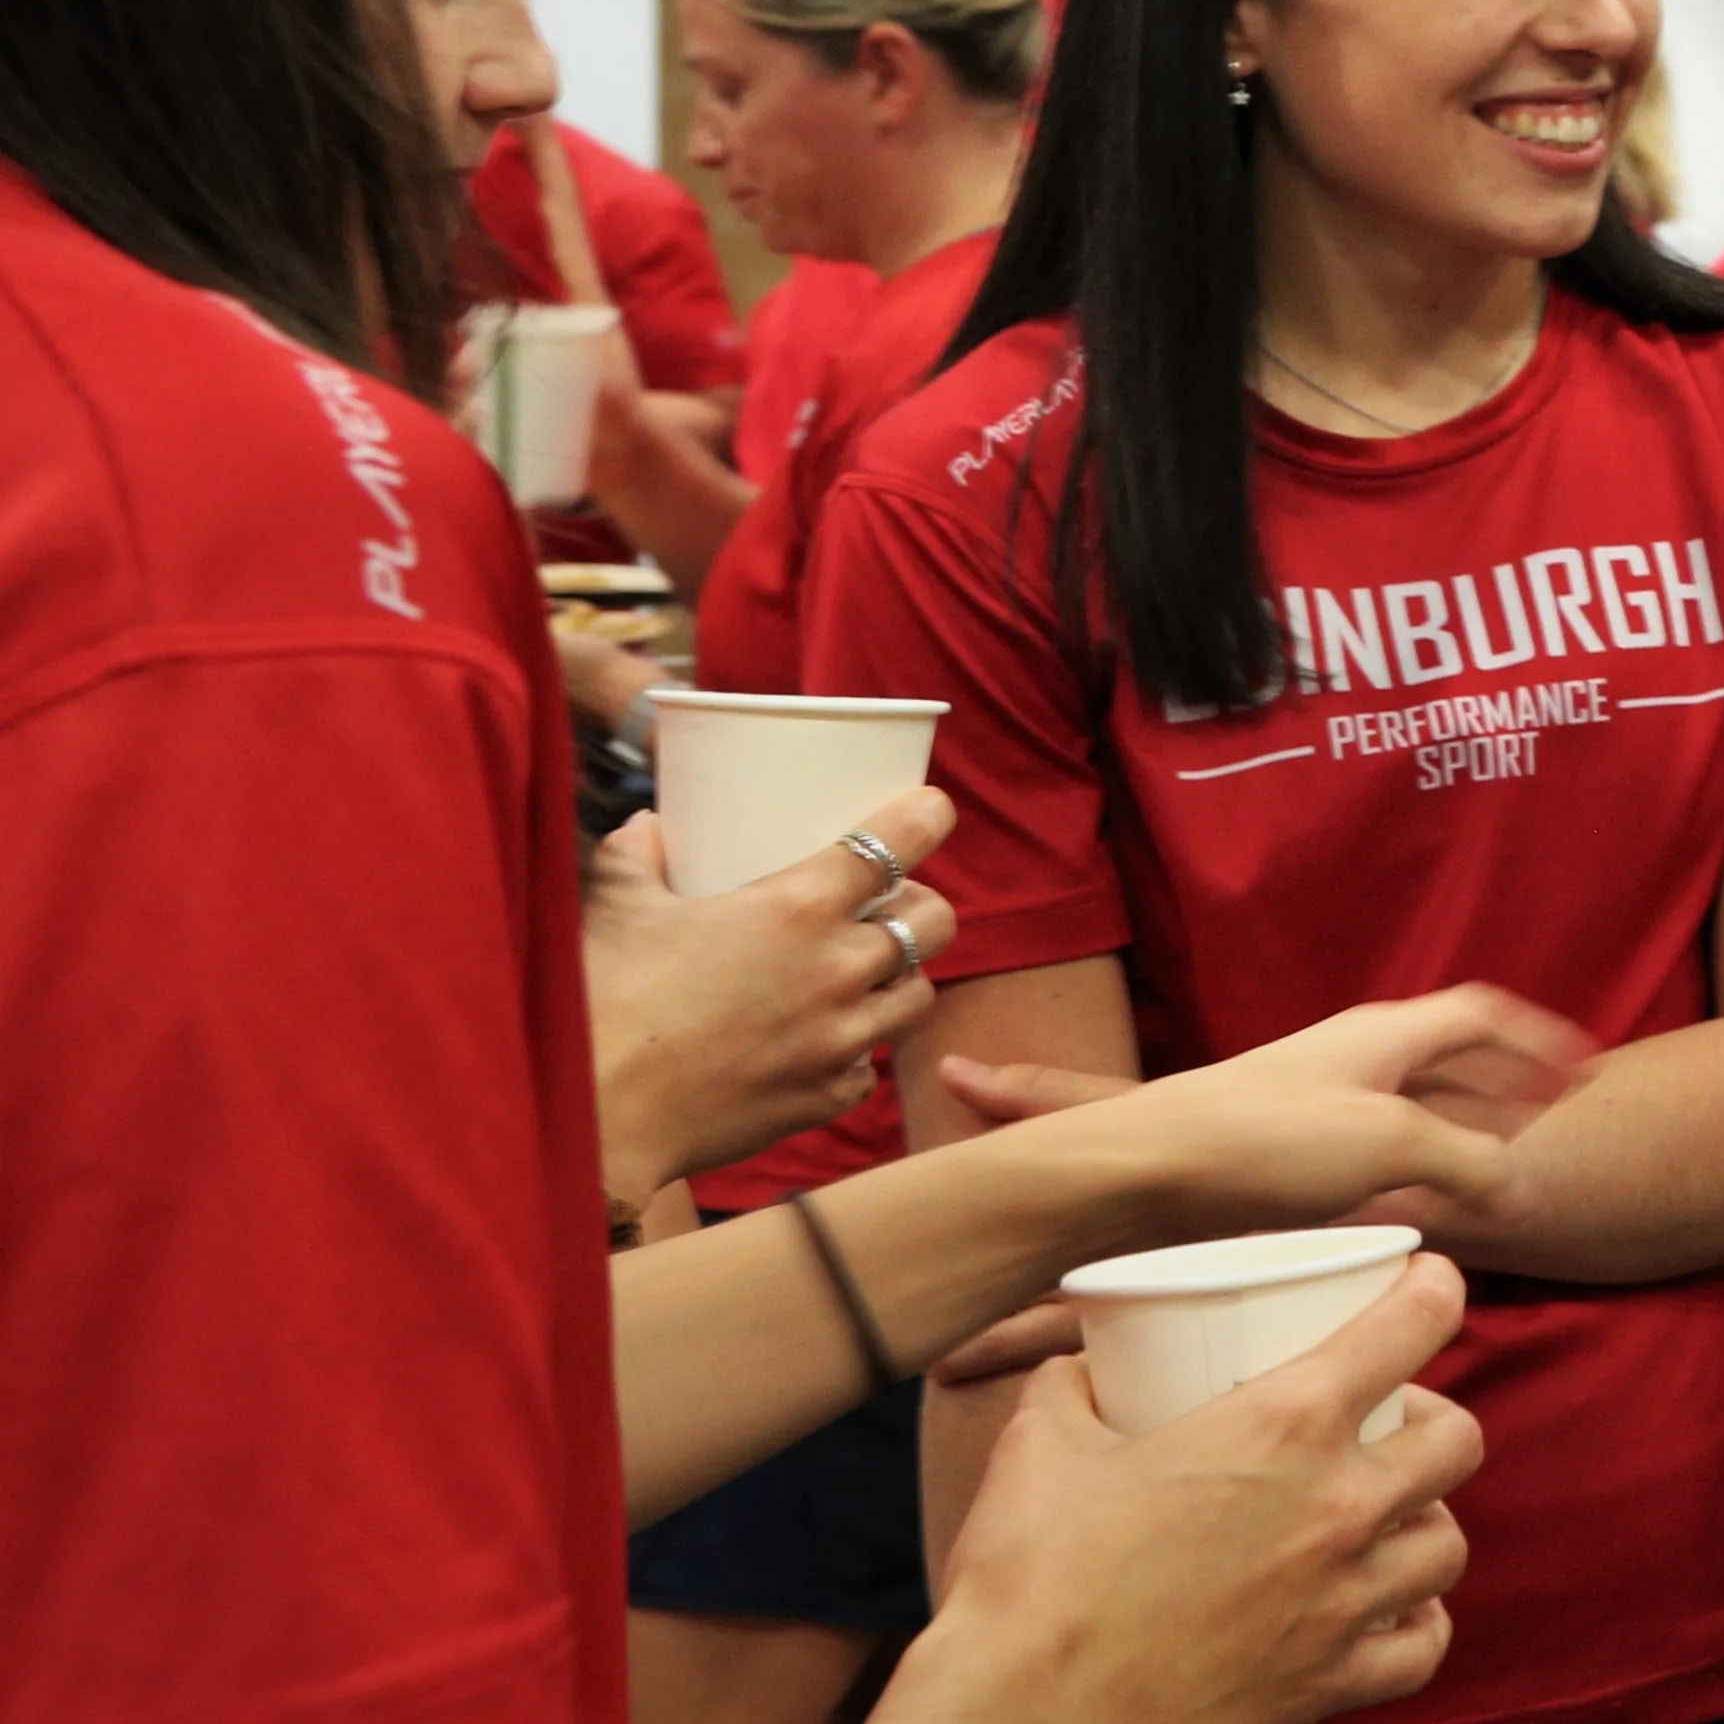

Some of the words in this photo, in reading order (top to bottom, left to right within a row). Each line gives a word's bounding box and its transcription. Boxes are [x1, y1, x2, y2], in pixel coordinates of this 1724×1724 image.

[1163, 537, 1724, 723] INBURGH
[1327, 678, 1611, 760] PERFORMANCE
[1416, 730, 1541, 791] SPORT
